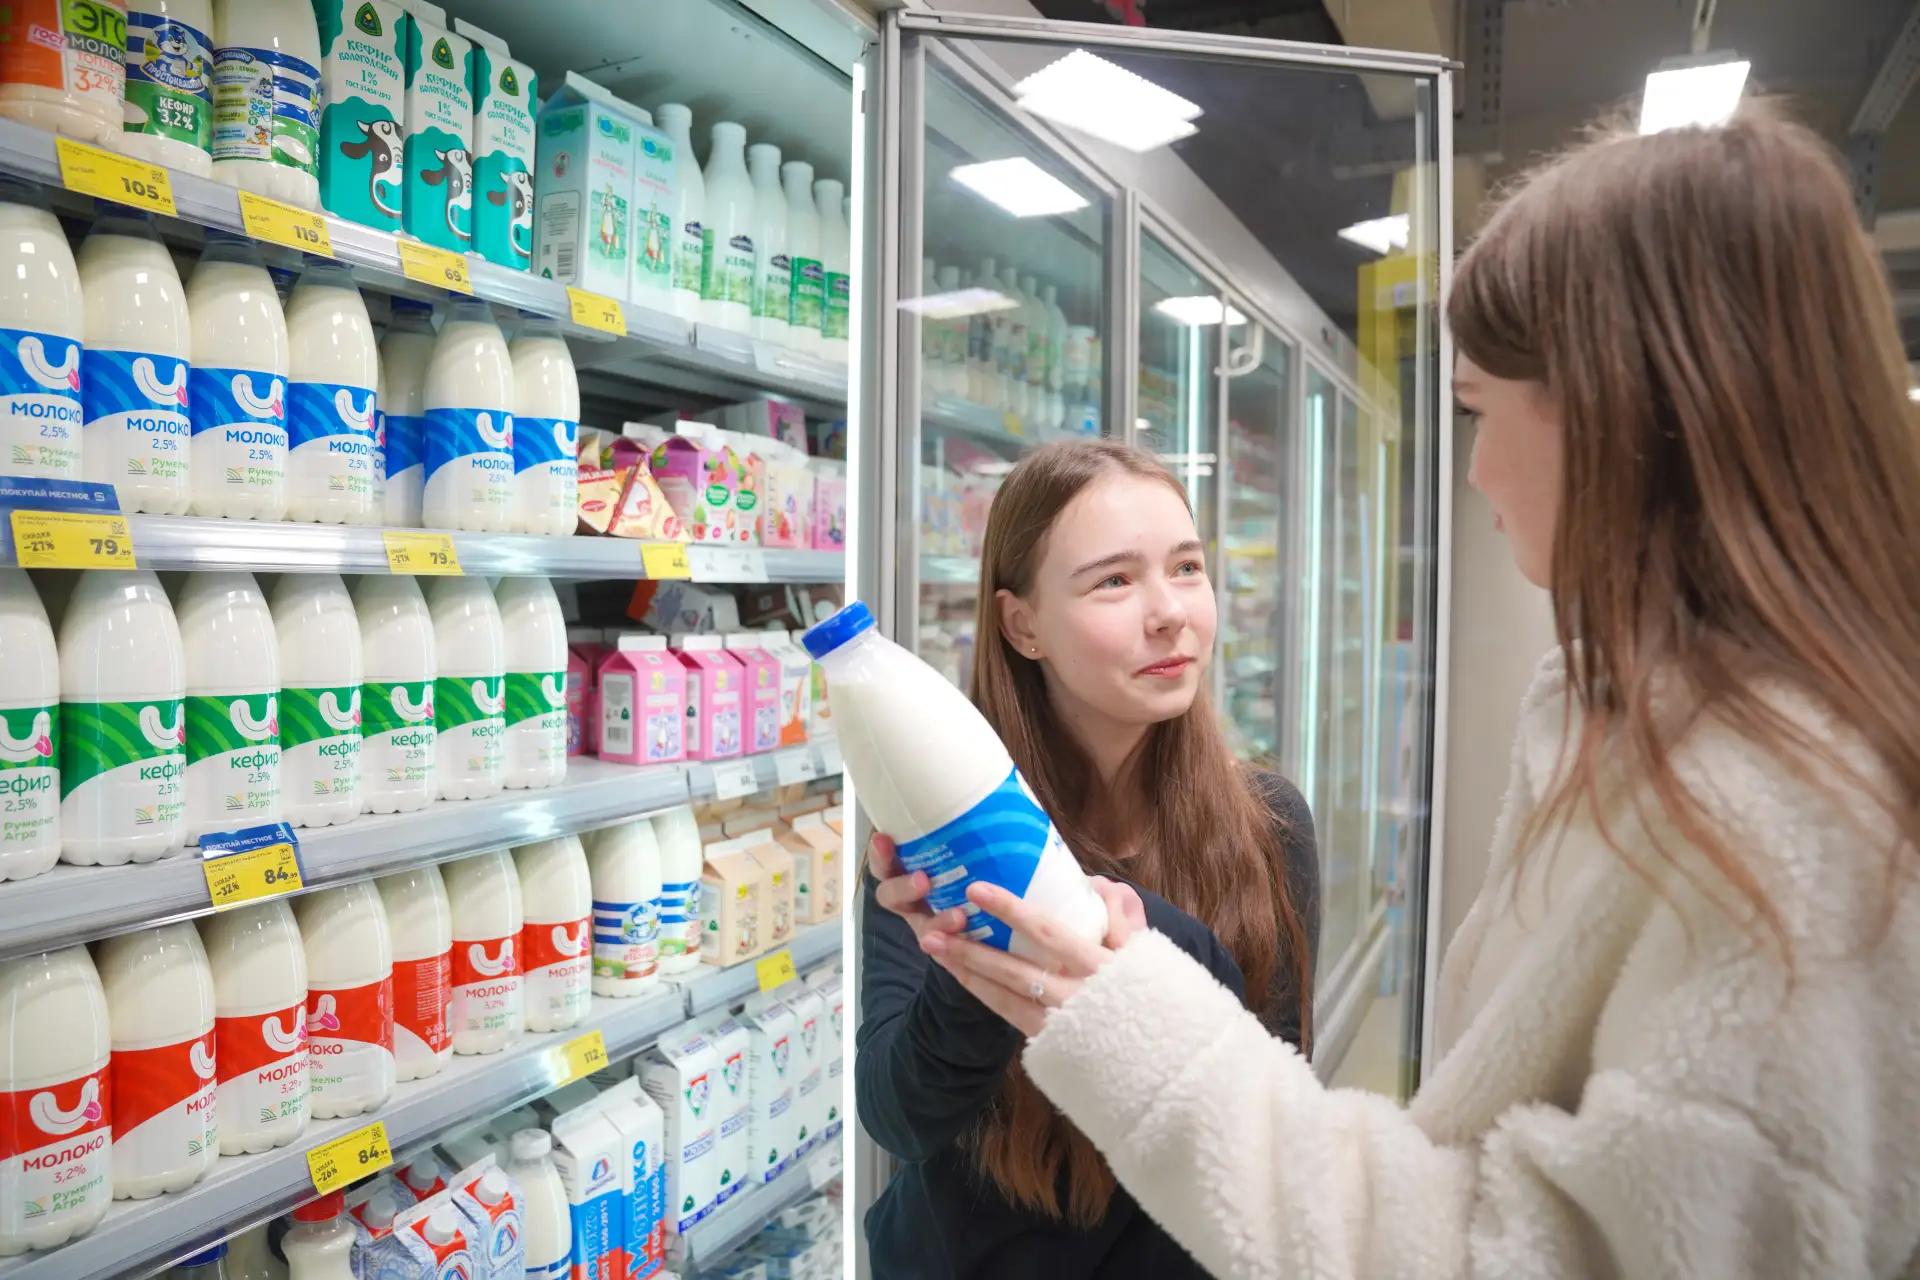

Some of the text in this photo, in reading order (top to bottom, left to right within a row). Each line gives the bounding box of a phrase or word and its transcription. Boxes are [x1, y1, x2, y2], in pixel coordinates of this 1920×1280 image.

[33, 27, 65, 45] ГОСТ
[70, 35, 126, 66] МОЛОК
[347, 40, 392, 62] КЕФИР
[339, 52, 399, 80] ВОЛОГОДСКИЙ
[361, 69, 378, 86] 1%
[425, 73, 463, 95] КЕФИР
[159, 96, 194, 116] КЕФИР
[437, 100, 452, 116] 1%
[493, 100, 527, 120] КЕФИР
[160, 108, 194, 131] 3,2%
[121, 176, 159, 200] 105
[293, 224, 319, 243] 119
[445, 268, 462, 283] 69
[12, 402, 81, 424] МОЛОКО
[40, 425, 69, 439] 2,5%
[127, 417, 189, 437] МОЛОКО
[152, 438, 178, 451] 2,5%
[226, 430, 285, 447] МОЛОКО
[39, 457, 68, 468] Агро
[248, 449, 273, 461] 2,5%
[152, 468, 177, 477] Агро
[348, 459, 368, 470] 2,5%
[248, 477, 273, 486] Агро
[0, 488, 90, 500] ПОКУПАЙ МЕСТНОЕ
[24, 540, 55, 552] -27%
[89, 538, 118, 555] 79
[429, 552, 447, 564] 79
[391, 731, 434, 747] кефир
[318, 740, 361, 758] кефир
[231, 751, 279, 770] кефир
[333, 759, 354, 771] 2,5%
[140, 760, 186, 781] кефир
[248, 771, 271, 783] 2,5%
[157, 783, 179, 796] 2,5%
[4, 798, 38, 813] 2,5%
[247, 798, 271, 809] Агро
[157, 812, 179, 822] Агро
[3, 829, 37, 841] Агро
[205, 834, 274, 851] ПОКУПАЙ МЕСТНОЕ
[264, 866, 289, 884] 84
[216, 881, 240, 896] -32%
[466, 981, 517, 998] МОЛОКО
[23, 1135, 104, 1172] МОЛОКО
[358, 1145, 380, 1164] 84
[54, 1164, 87, 1184] 3,2%
[52, 1175, 104, 1202] Румелко
[52, 1194, 86, 1213] Агро
